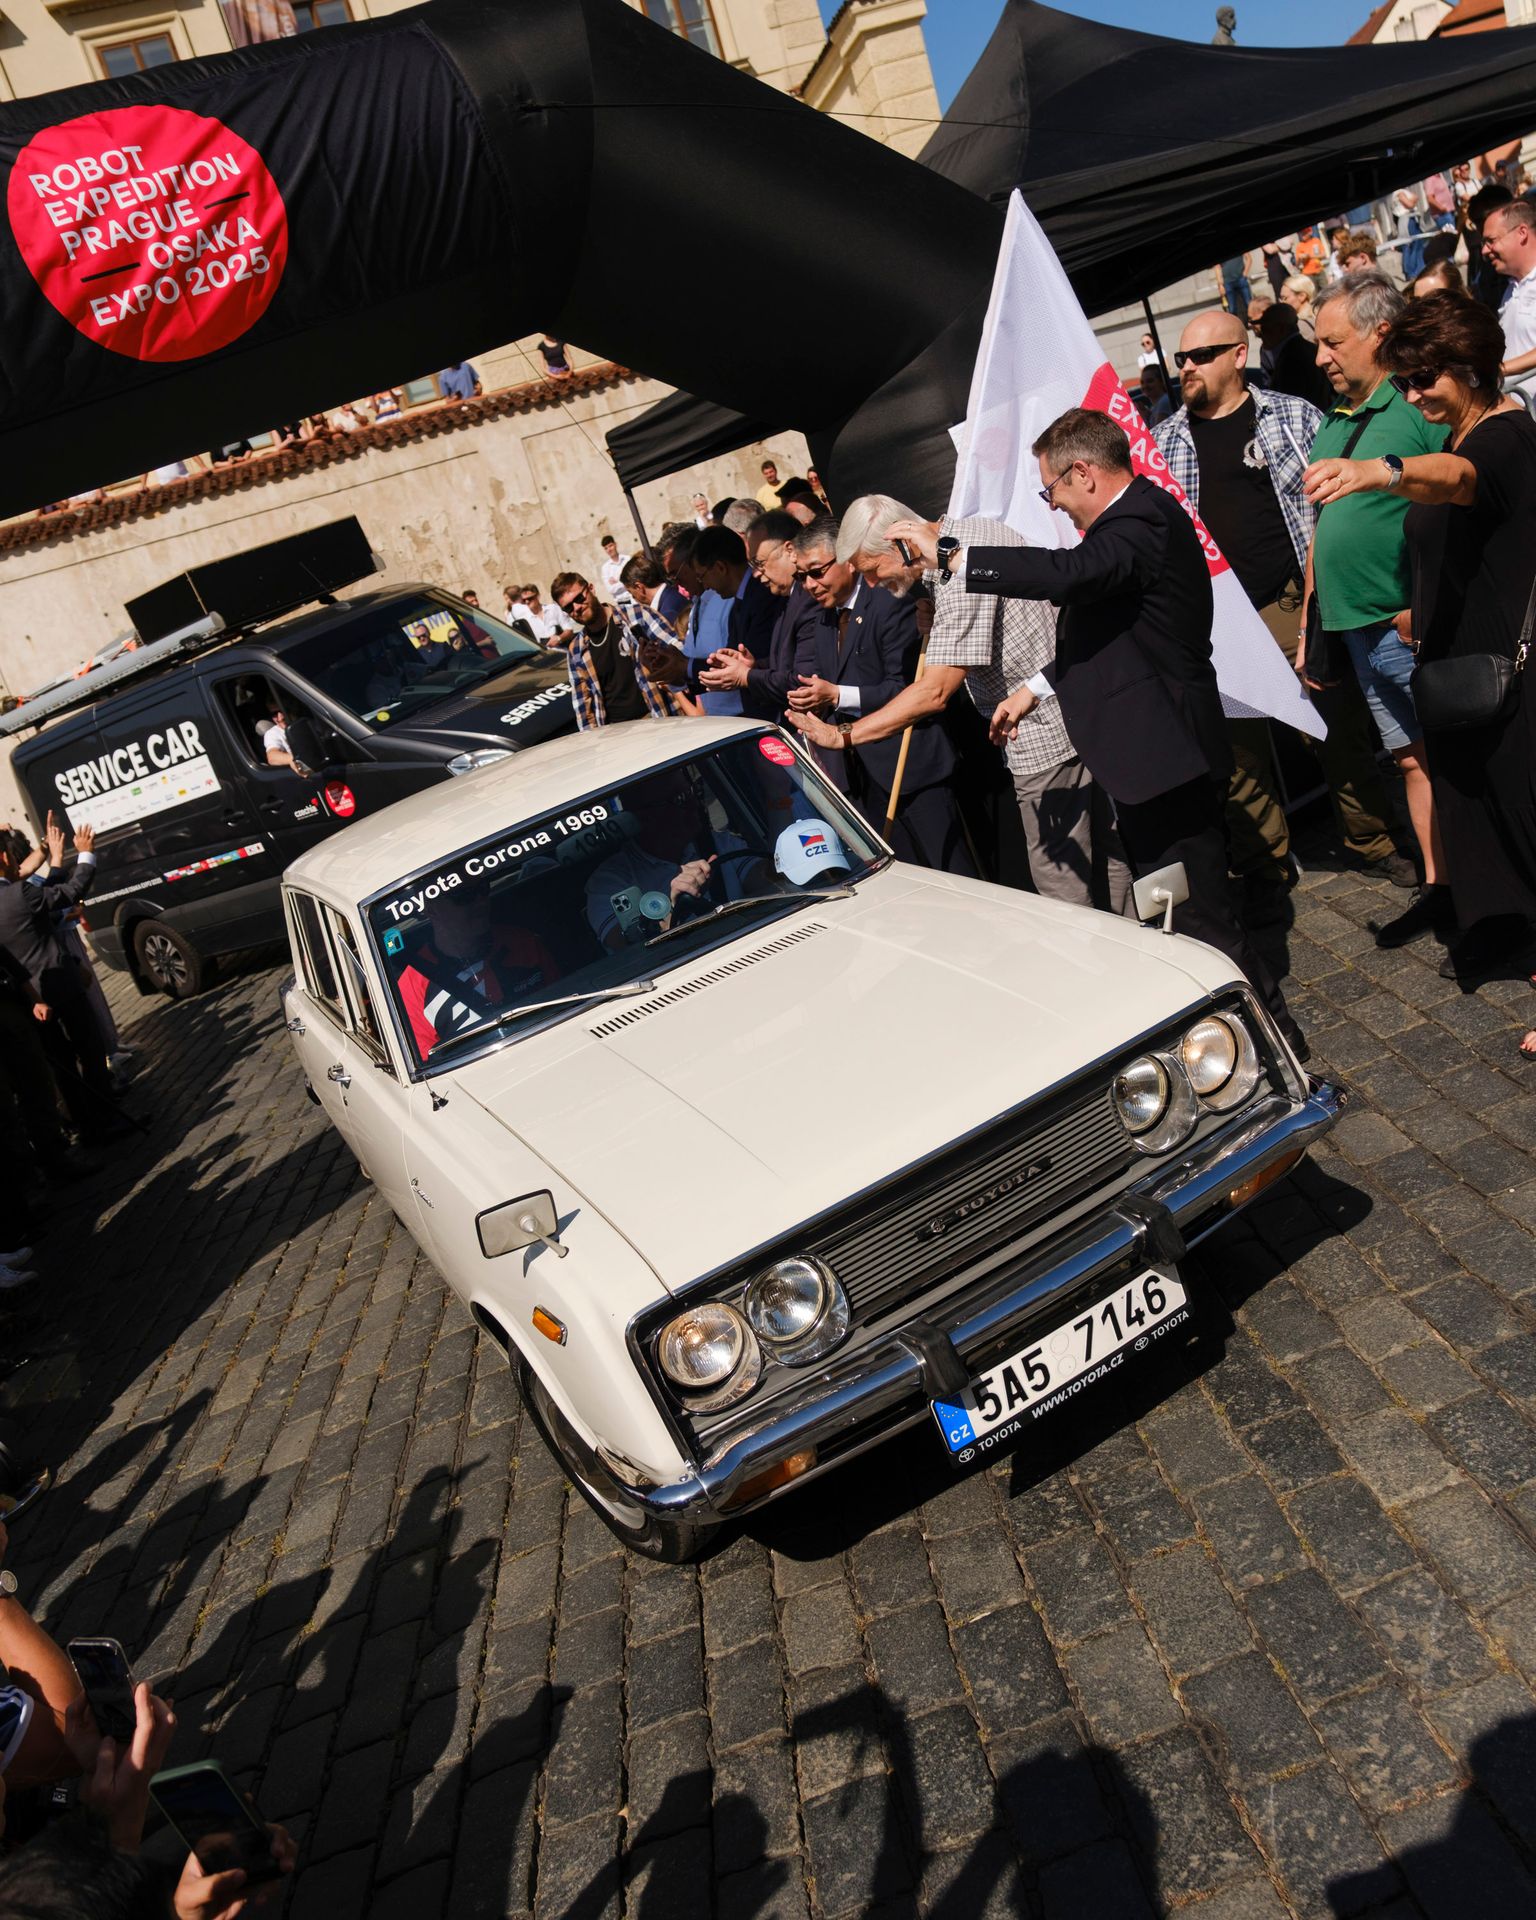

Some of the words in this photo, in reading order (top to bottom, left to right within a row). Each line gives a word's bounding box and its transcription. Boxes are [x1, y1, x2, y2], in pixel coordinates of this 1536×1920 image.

[28, 145, 145, 199] ROBOT
[44, 152, 242, 228] EXPEDITION
[60, 198, 201, 261] PRAGUE
[147, 216, 261, 270] OSAKA
[89, 275, 180, 327] EXPO
[185, 246, 271, 297] 2025
[500, 682, 573, 726] SERVICE
[54, 741, 150, 805] SERVICE
[146, 720, 207, 769] CAR
[384, 872, 463, 921] Toyota
[464, 831, 551, 876] Corona
[554, 805, 608, 836] 1969
[805, 844, 829, 858] CZE
[955, 1165, 1042, 1217] TOYOTA
[970, 1346, 1051, 1422] 5A5
[1073, 1274, 1167, 1363] 7146
[977, 1419, 1022, 1452] TOYOTA
[1031, 1352, 1124, 1420] WWW.TOYOTA.CZ
[1150, 1309, 1190, 1341] TOYOTA
[950, 1423, 971, 1444] CZ
